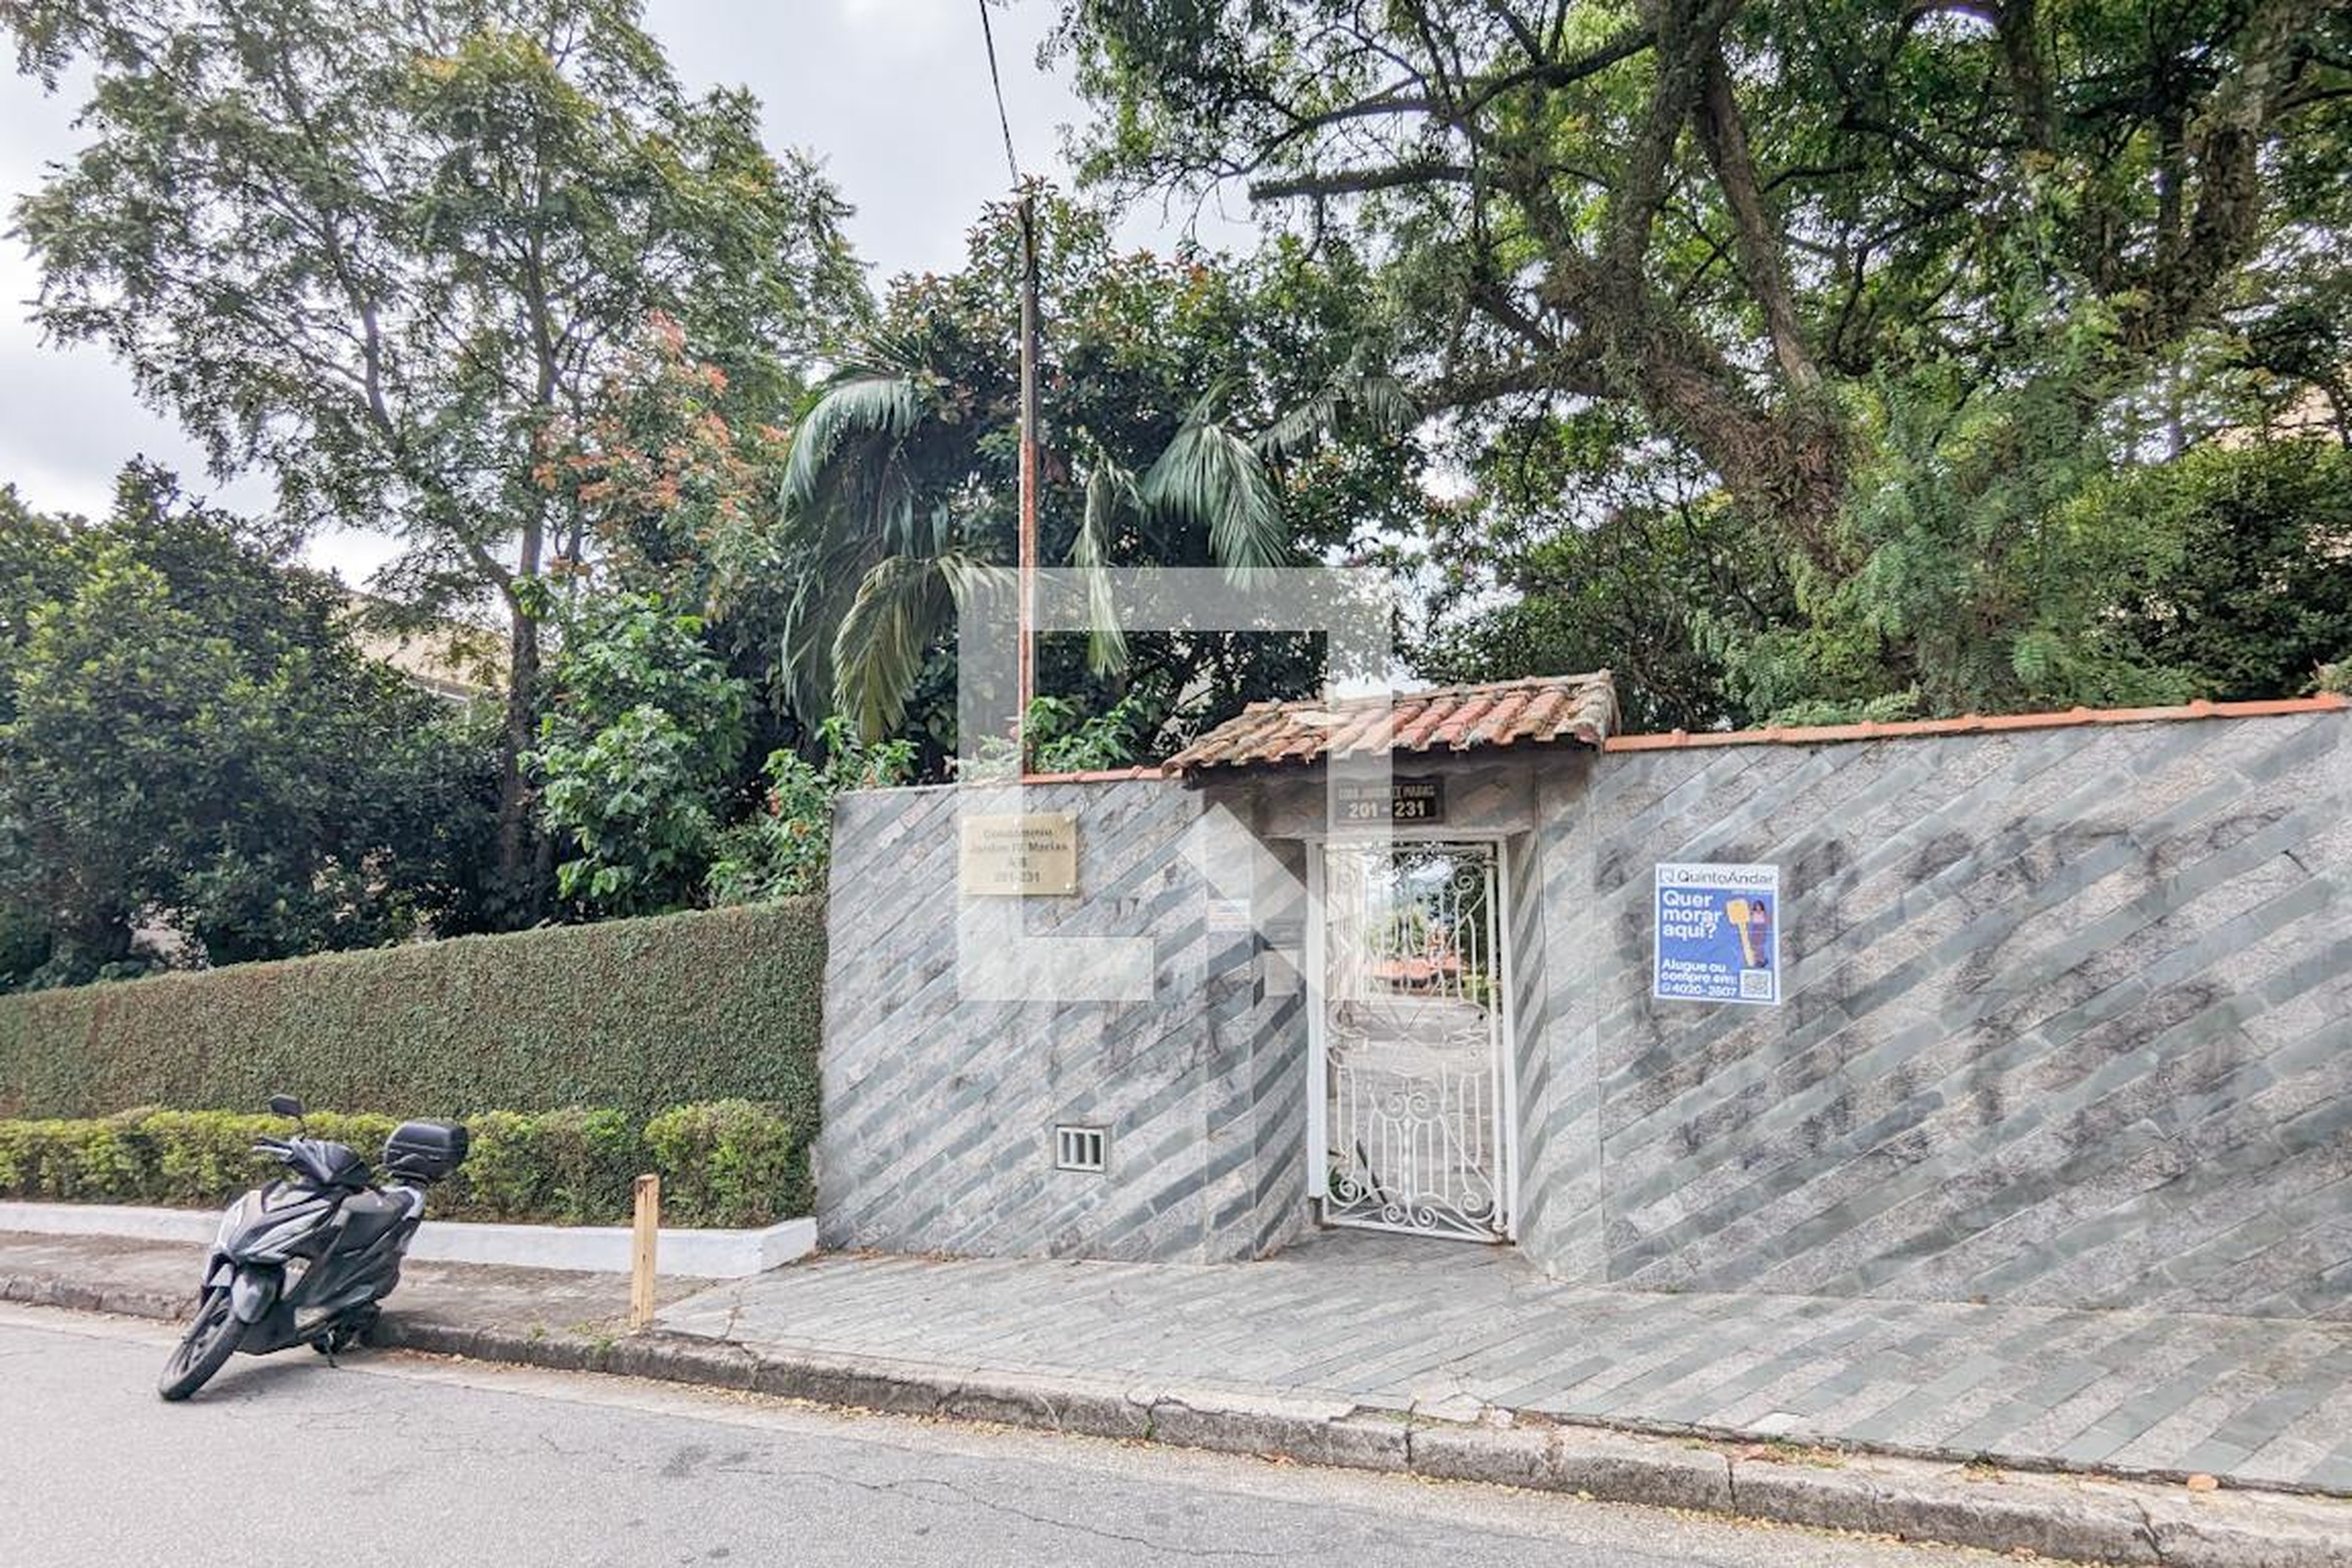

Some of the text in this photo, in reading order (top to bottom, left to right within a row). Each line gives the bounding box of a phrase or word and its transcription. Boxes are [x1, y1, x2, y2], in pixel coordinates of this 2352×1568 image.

[1348, 802, 1378, 818] 201
[1393, 800, 1425, 817] 231
[1678, 869, 1775, 885] QuintoAndar
[1662, 890, 1713, 907] Quer
[1662, 908, 1722, 923] morar
[1662, 922, 1717, 941] aqui?
[1662, 958, 1726, 973] Alugue ou
[1661, 971, 1711, 984] compre
